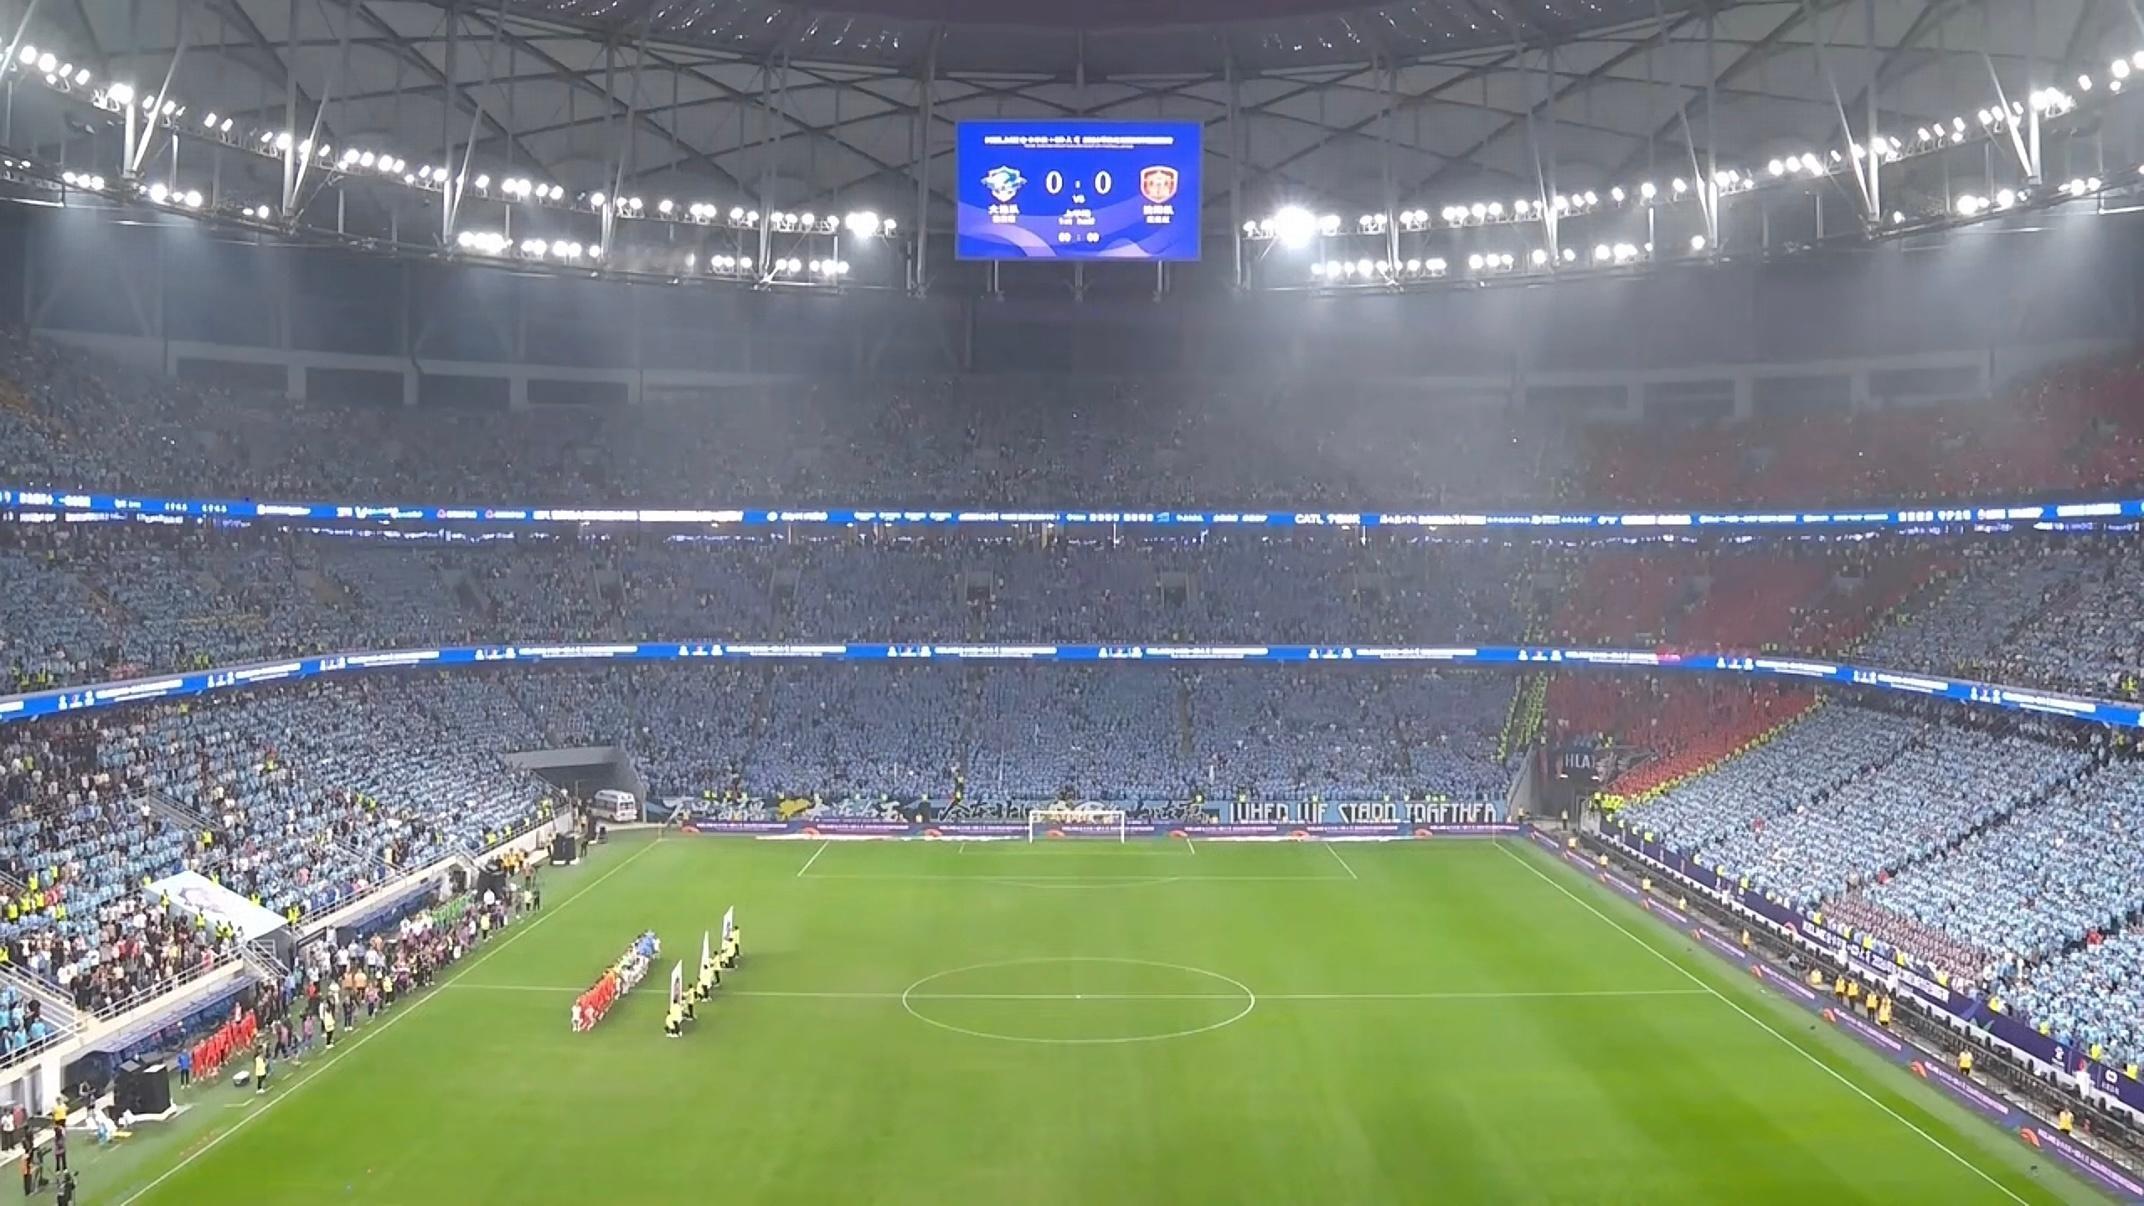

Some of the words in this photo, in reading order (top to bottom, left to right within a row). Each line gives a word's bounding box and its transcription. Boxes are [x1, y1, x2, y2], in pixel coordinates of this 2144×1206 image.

[1046, 170, 1063, 194] 0
[1095, 170, 1112, 194] 0
[1294, 513, 1324, 525] CATL
